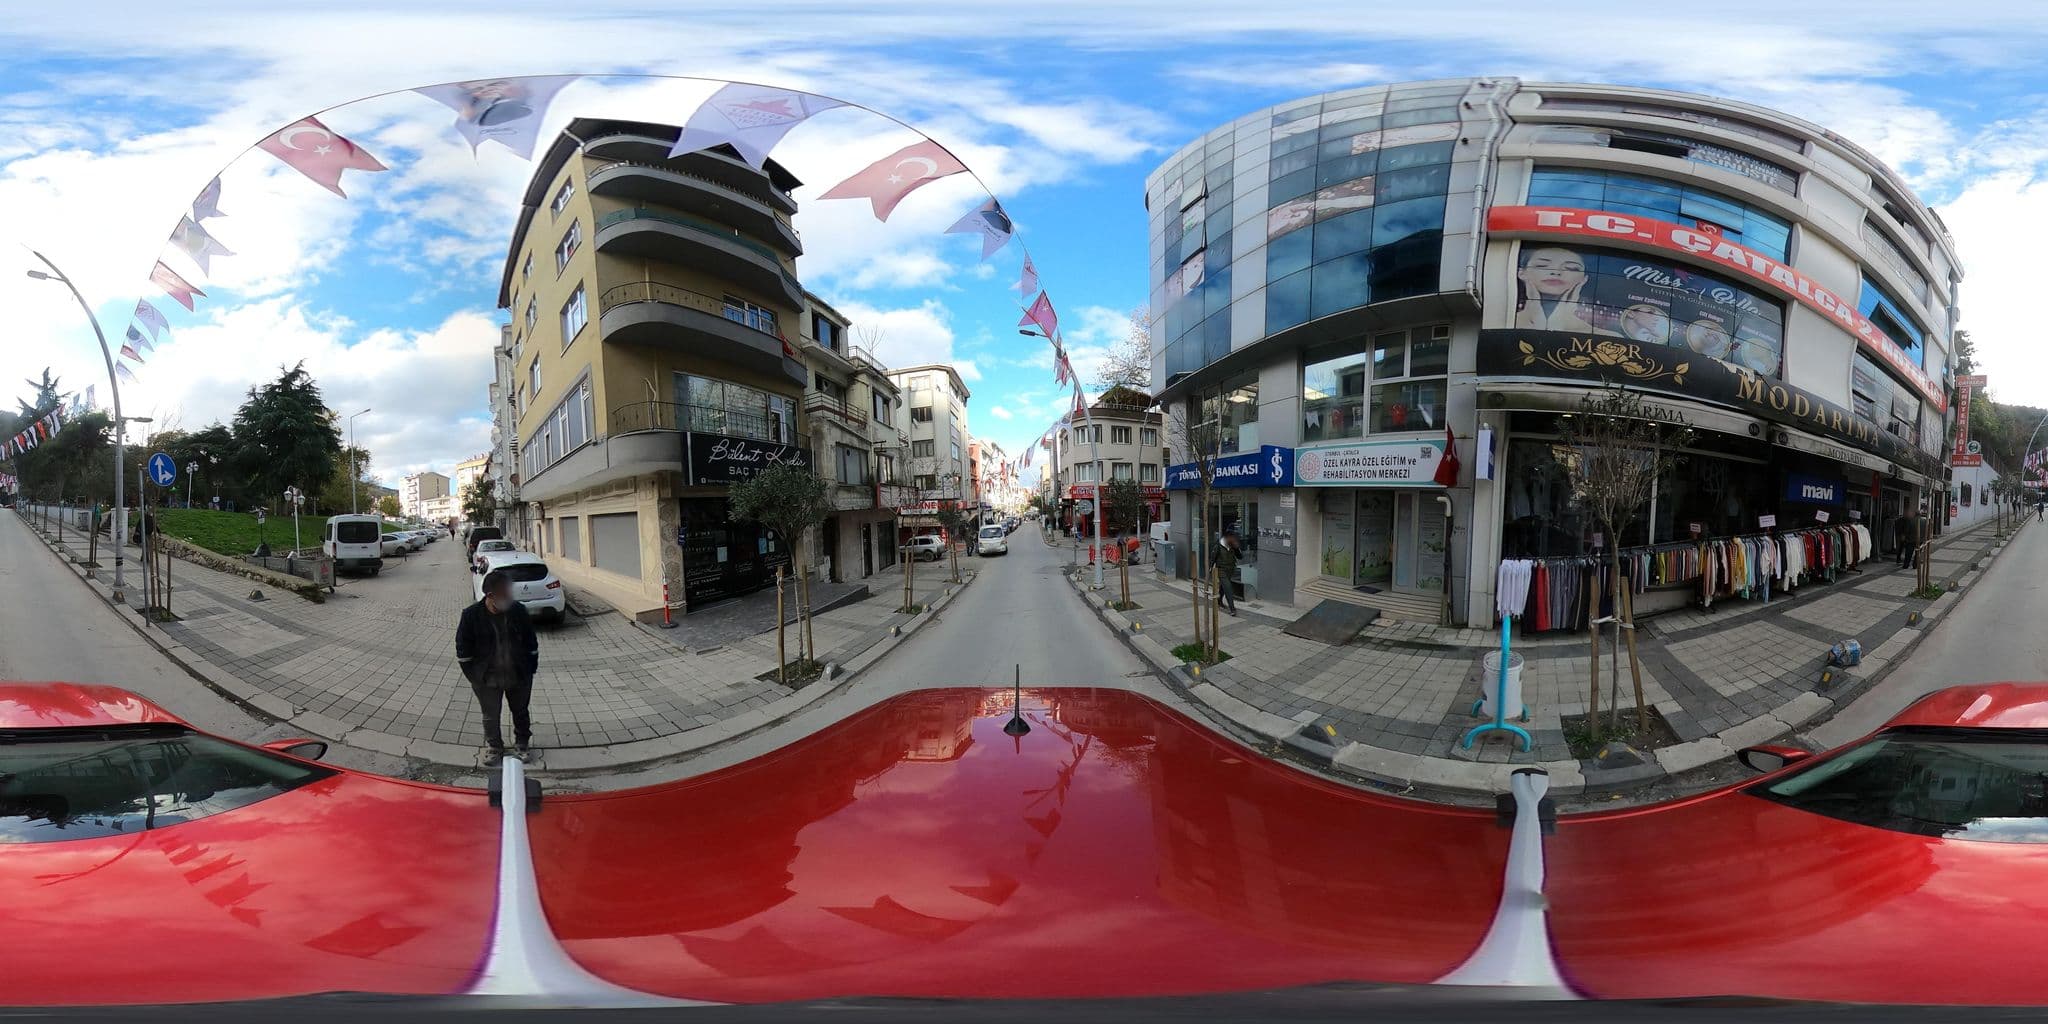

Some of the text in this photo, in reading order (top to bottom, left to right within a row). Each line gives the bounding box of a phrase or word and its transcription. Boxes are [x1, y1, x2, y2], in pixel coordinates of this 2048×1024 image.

[1536, 211, 1652, 238] T.C.
[1671, 229, 1853, 326] ÇATALCA
[1624, 265, 1685, 290] Miss
[708, 438, 762, 463] Bülent
[1324, 457, 1338, 468] ÖZEL
[1340, 457, 1361, 467] KAYRA
[1362, 456, 1380, 466] ÖZEL
[1381, 454, 1406, 466] EĞİTİM
[1216, 463, 1258, 477] BANKASI
[1378, 467, 1410, 479] MERKEZİ
[1802, 484, 1833, 501] mavi
